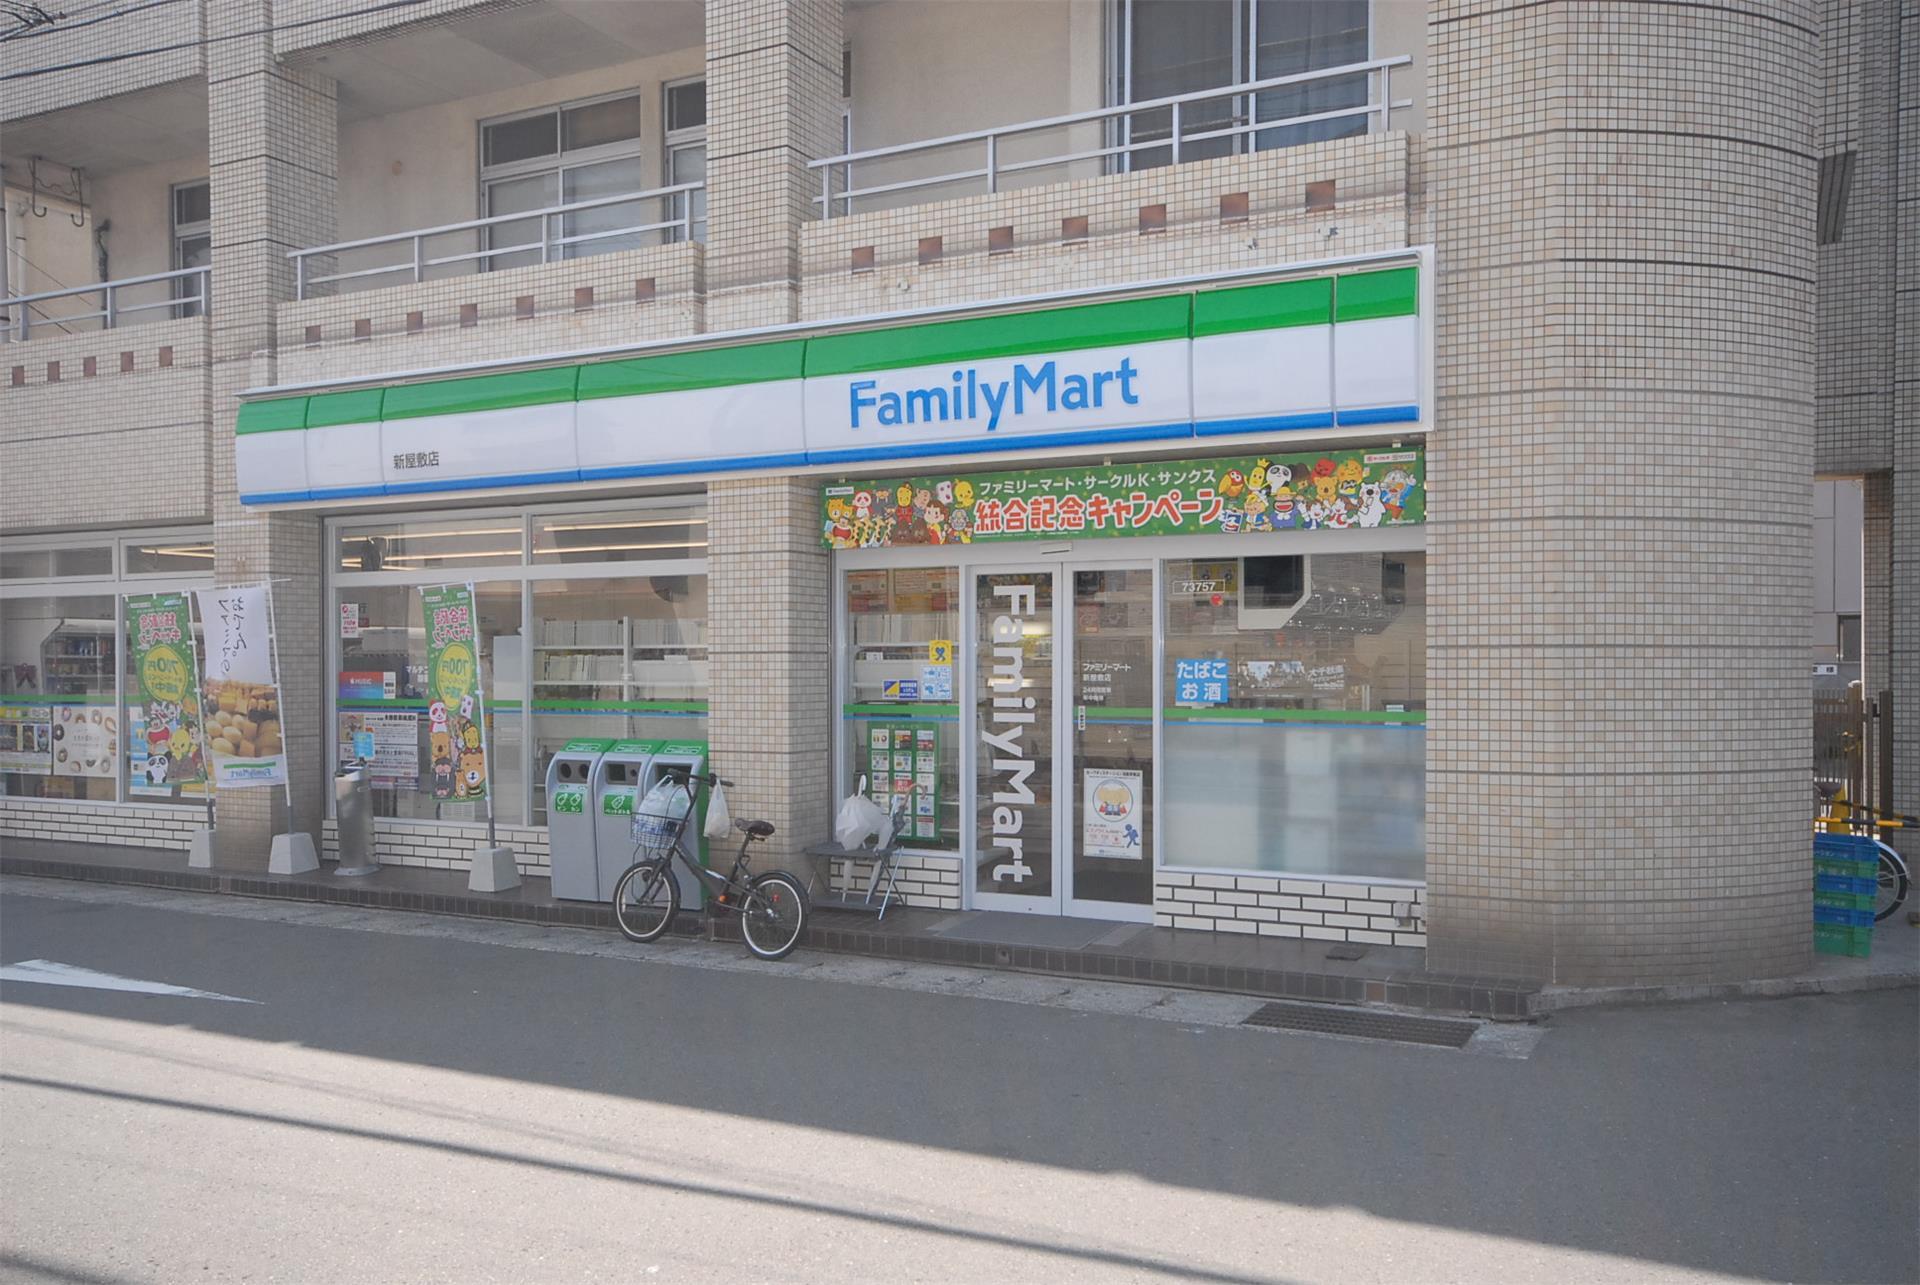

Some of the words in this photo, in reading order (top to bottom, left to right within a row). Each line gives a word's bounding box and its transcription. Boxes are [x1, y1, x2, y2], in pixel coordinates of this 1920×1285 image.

[850, 357, 1138, 431] FamilyMart
[393, 451, 440, 470] 新屋敷店
[979, 469, 1216, 494] ファミリーマート・サークルK・サンクス
[975, 489, 1223, 532] 統合記念キャンペーン
[1181, 581, 1216, 592] 73757
[1082, 663, 1132, 672] ファミリーマート
[1176, 661, 1228, 680] たばこ
[1182, 682, 1221, 700] お酒
[981, 585, 1036, 882] FamilyMart
